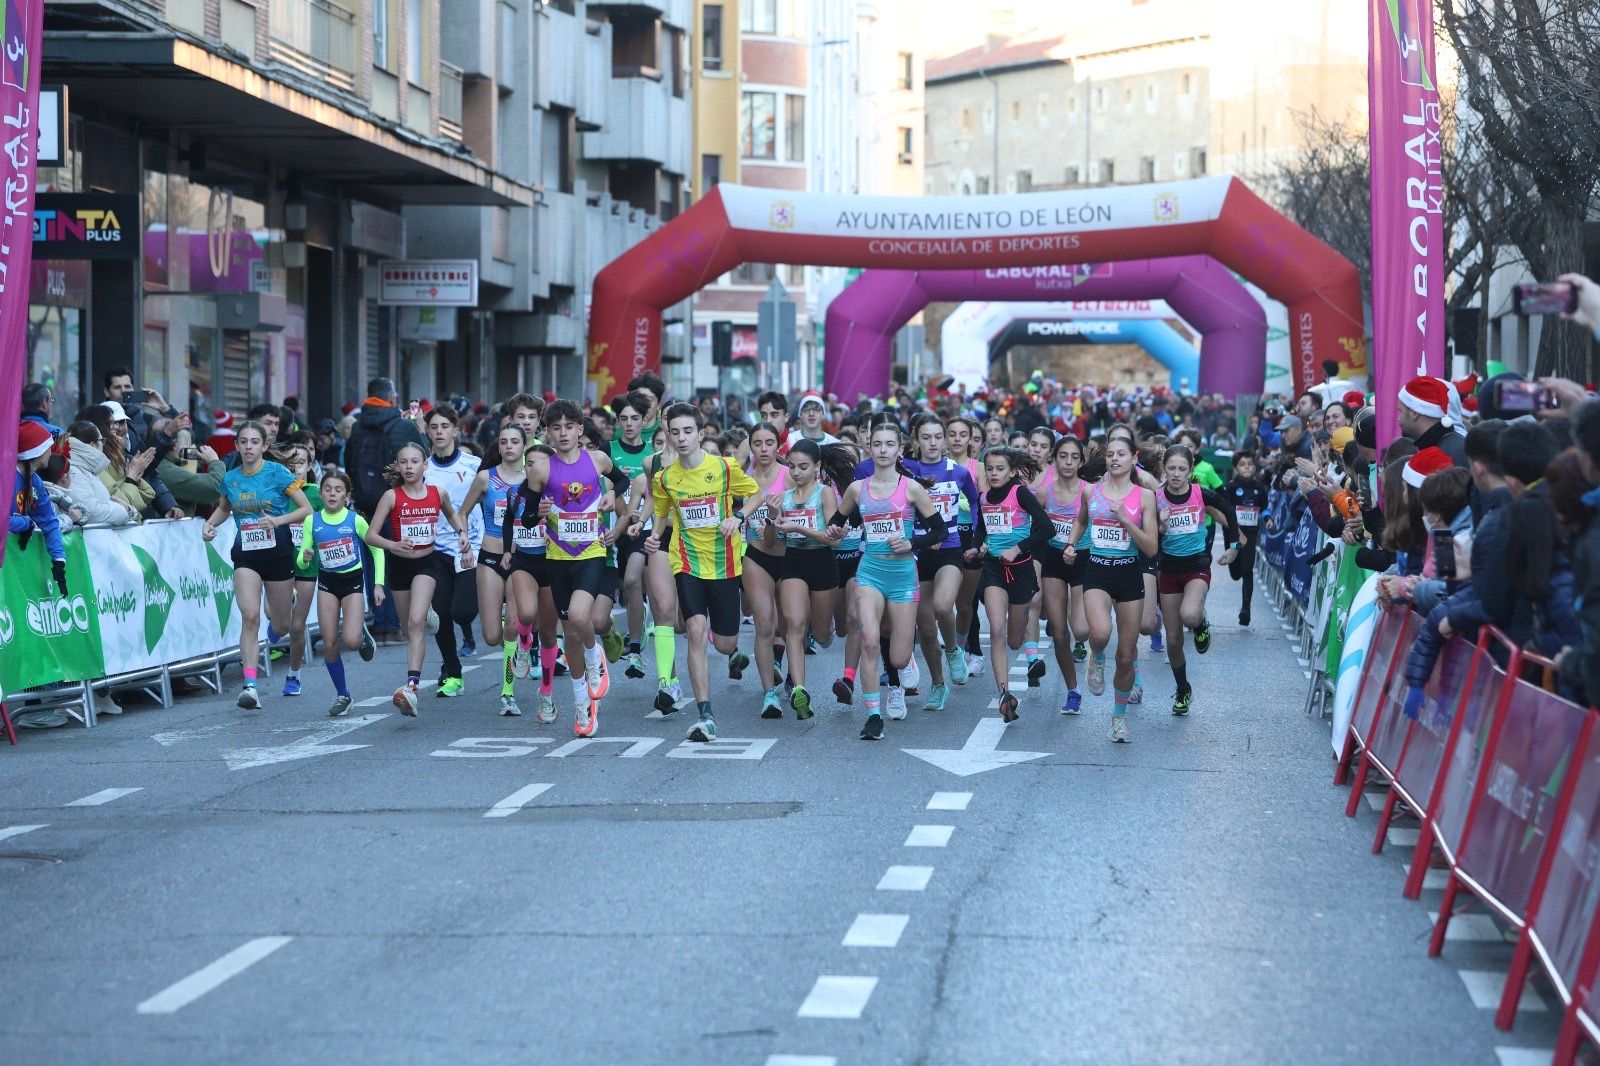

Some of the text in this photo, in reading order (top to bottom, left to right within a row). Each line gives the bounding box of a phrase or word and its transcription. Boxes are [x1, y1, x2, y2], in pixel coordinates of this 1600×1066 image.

[836, 203, 1112, 231] AYUNTAMIENTO DE LEÓN
[86, 230, 121, 241] PLUS
[868, 235, 1080, 255] CONCEJALÍA DE DEPORTES
[1028, 321, 1121, 336] POWERADE
[686, 507, 707, 520] 3007
[564, 521, 588, 533] 3008
[871, 521, 893, 533] 3052
[1169, 515, 1191, 528] 3049
[245, 530, 265, 542] 3063
[407, 526, 429, 537] 3044
[517, 528, 538, 539] 3064
[1097, 528, 1120, 541] 3055
[324, 547, 346, 560] 3065
[836, 551, 860, 560] NIKE
[1089, 554, 1136, 566] NIKE PRO
[428, 736, 780, 761] BUS
